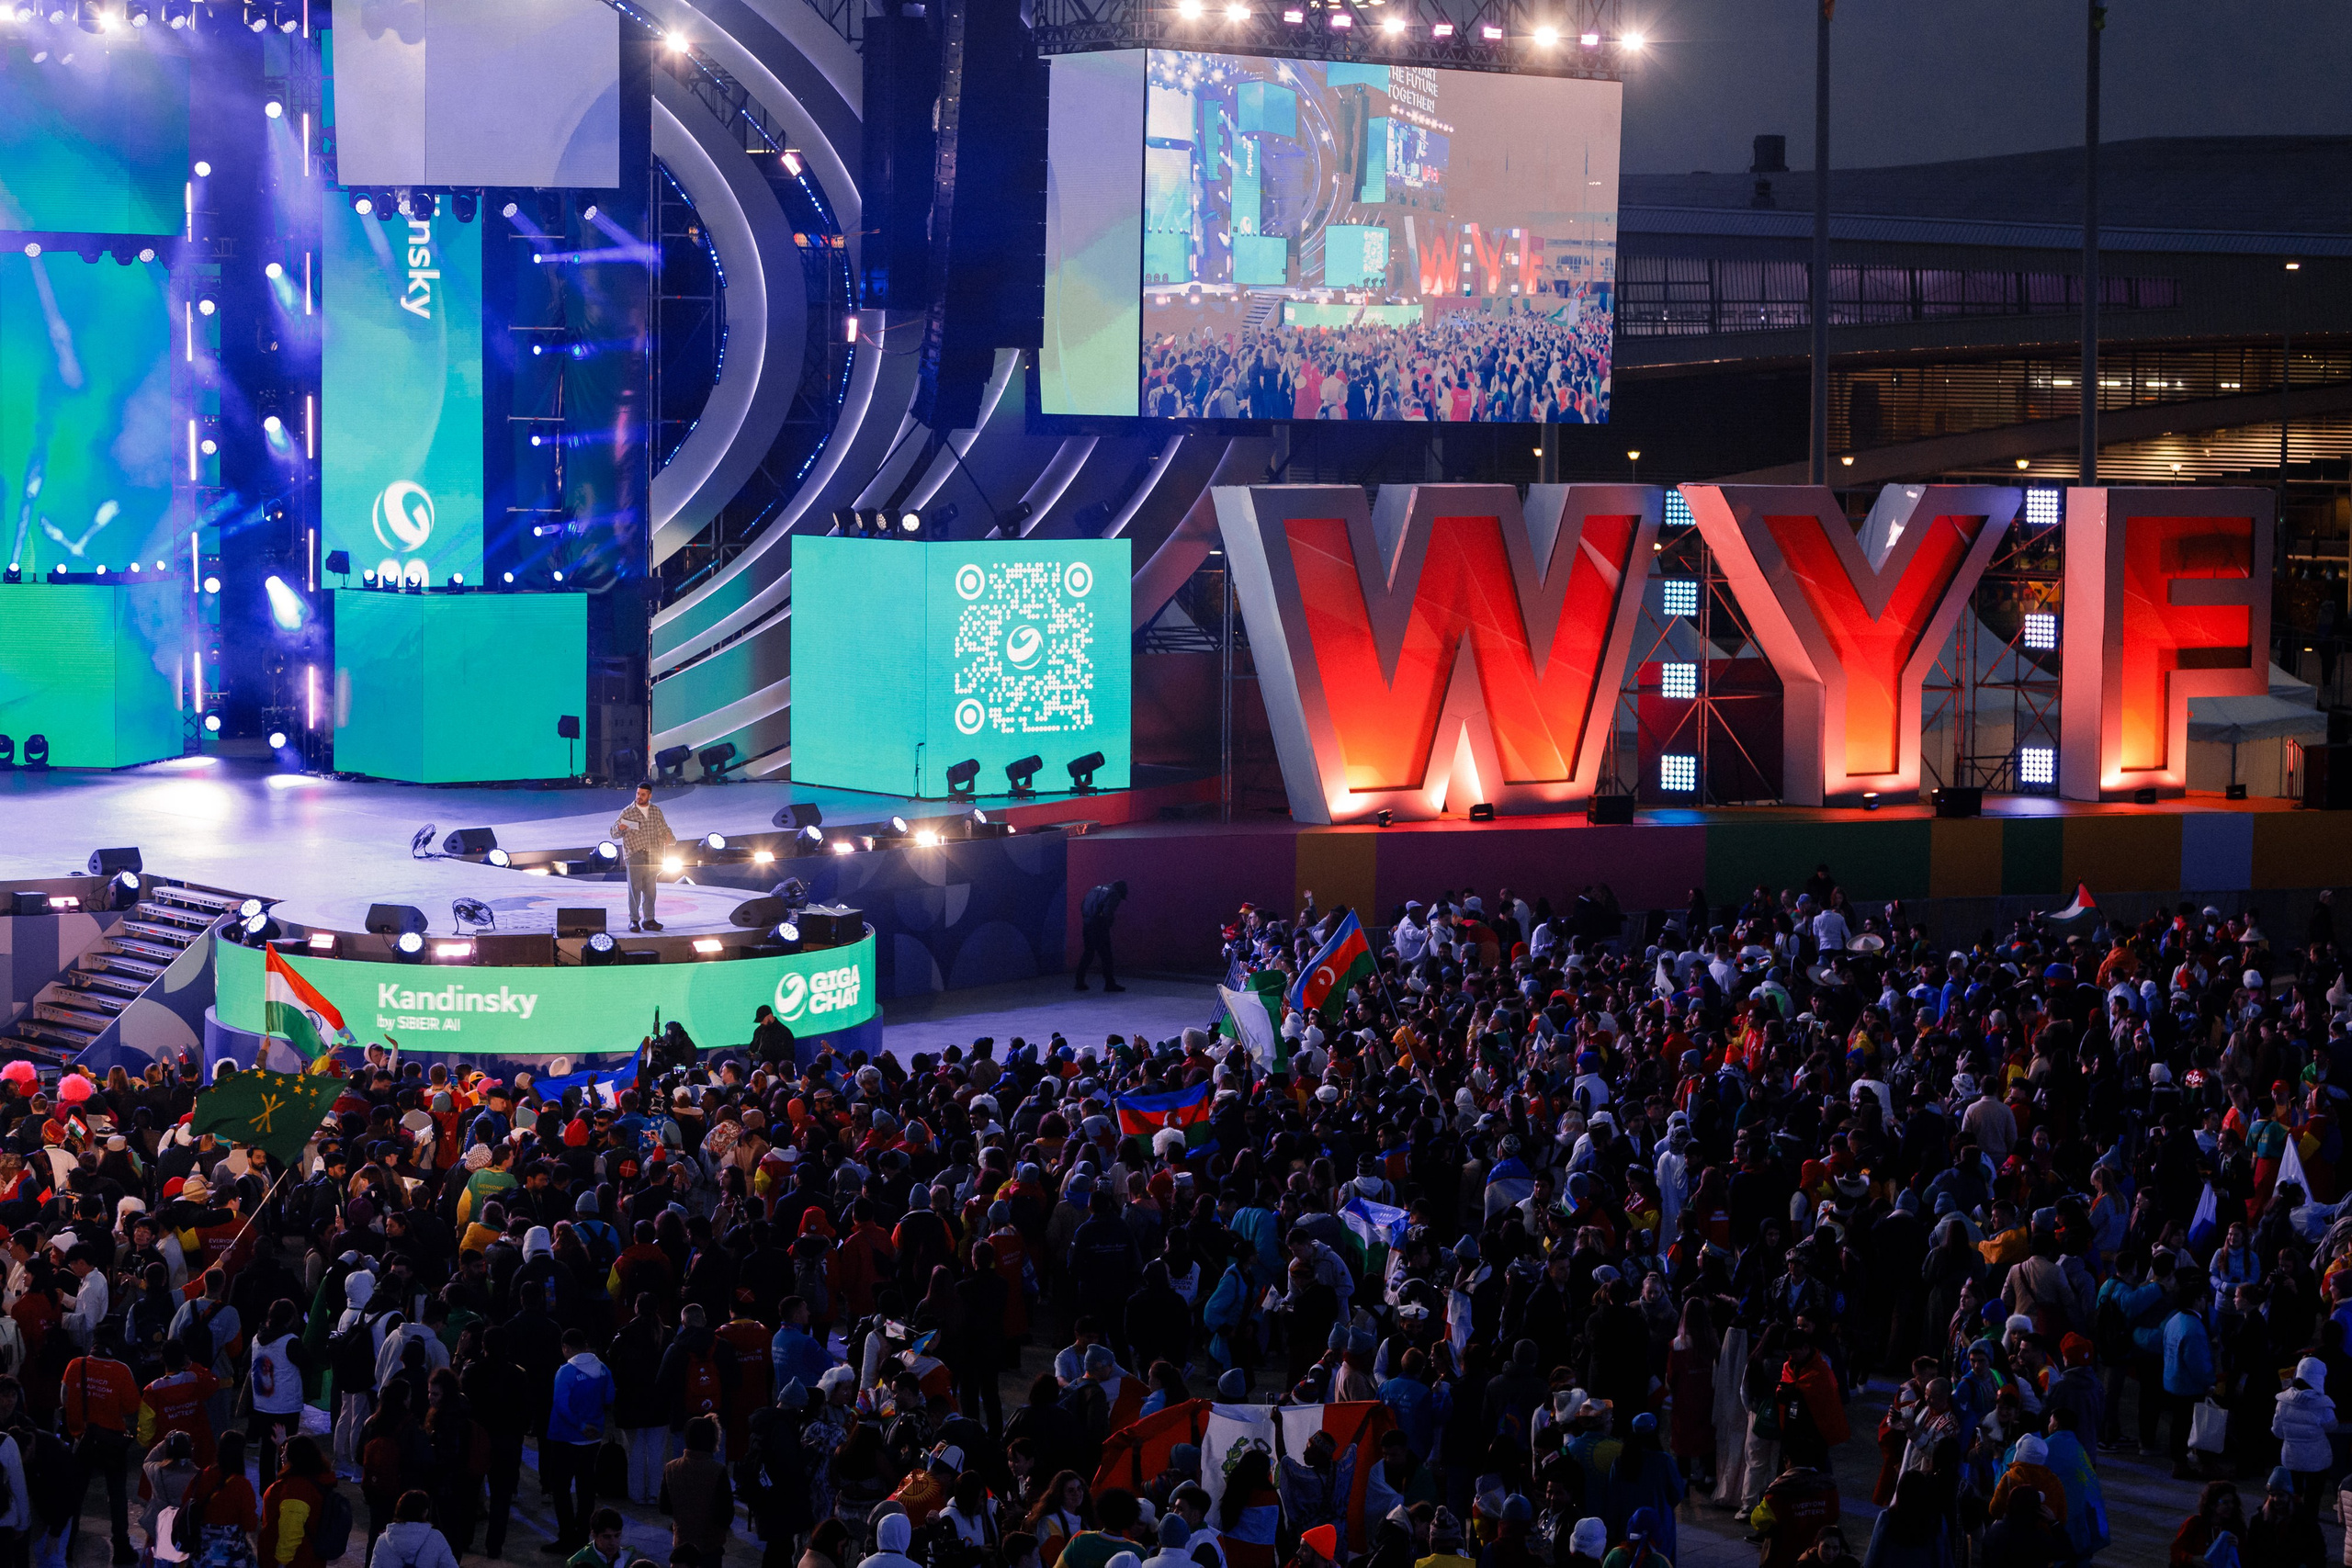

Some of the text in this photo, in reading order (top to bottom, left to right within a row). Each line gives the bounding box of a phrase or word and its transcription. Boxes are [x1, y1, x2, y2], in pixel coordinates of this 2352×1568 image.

[1388, 65, 1439, 97] THE FUTURE
[1388, 84, 1435, 114] TOGETHER!
[809, 964, 860, 993] GIGA
[378, 983, 538, 1019] Kandinsky
[809, 984, 860, 1014] CHAT
[377, 1014, 395, 1031] by
[397, 1016, 440, 1031] SBER
[86, 1377, 108, 1386] МЫСЛ
[86, 1384, 113, 1394] АЖДОМ
[167, 1409, 196, 1420] MATTER
